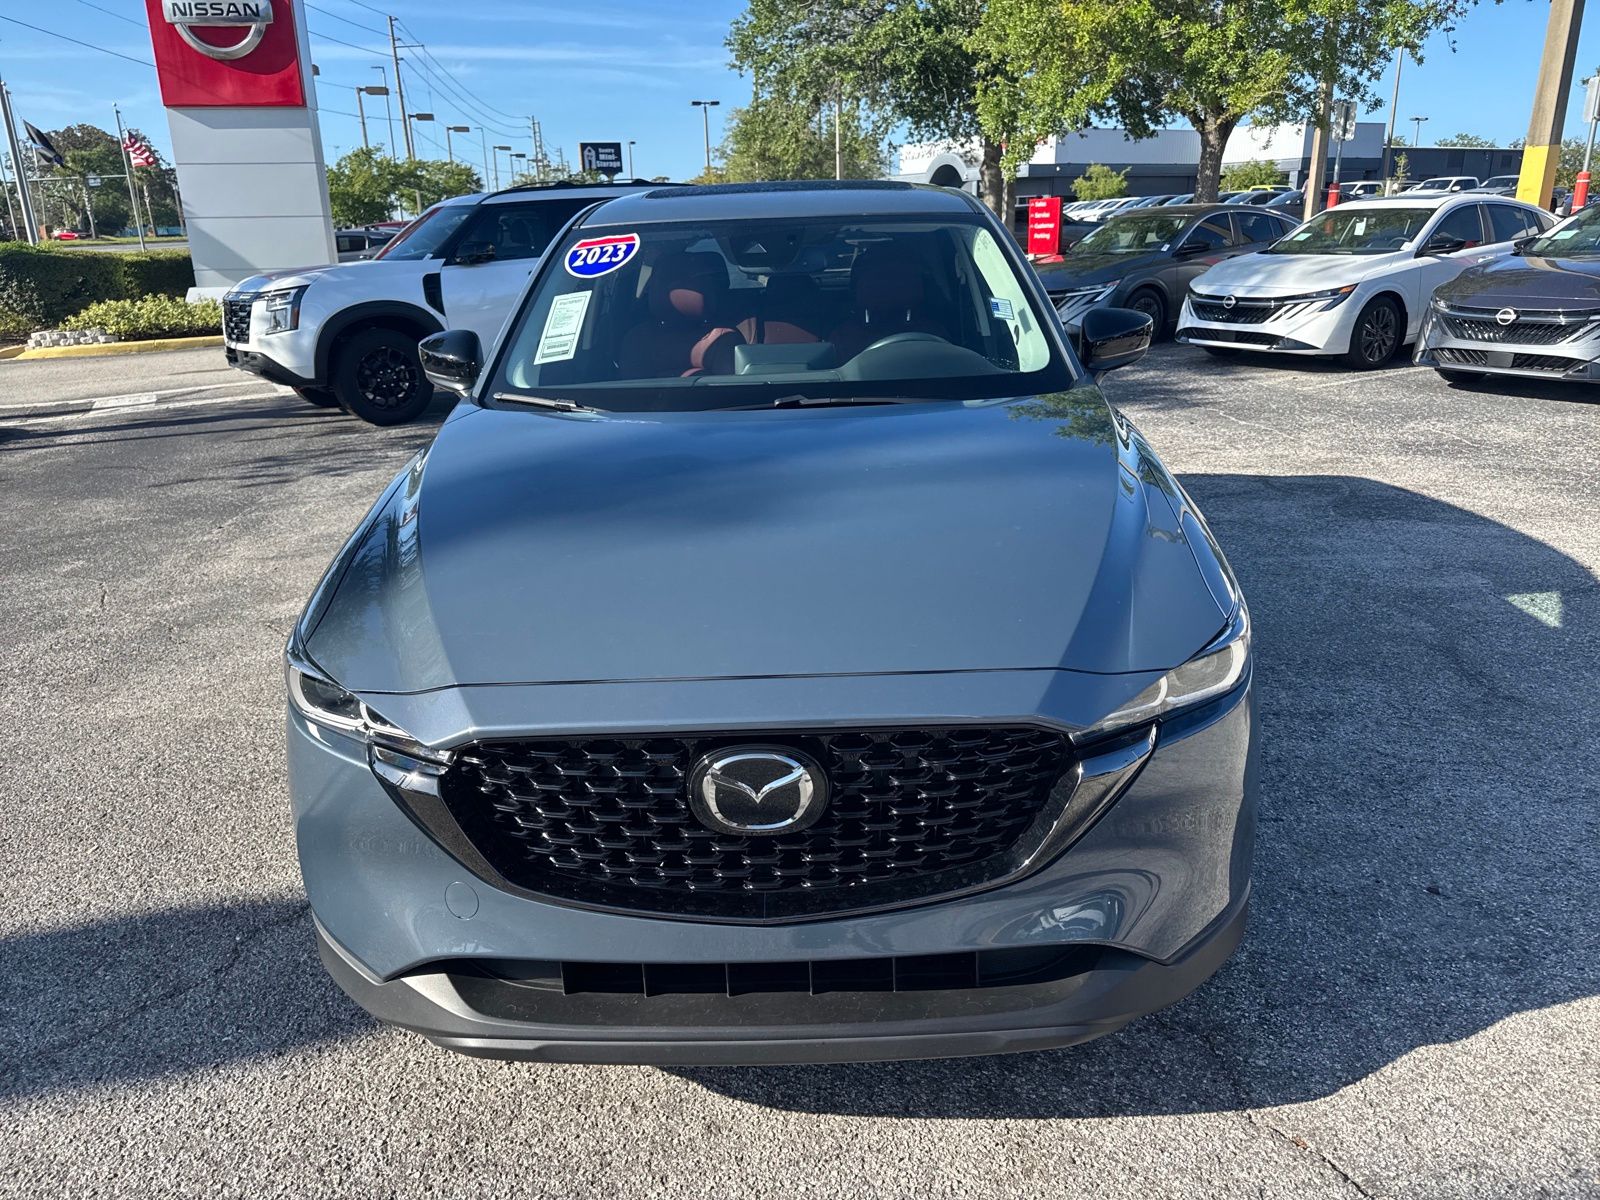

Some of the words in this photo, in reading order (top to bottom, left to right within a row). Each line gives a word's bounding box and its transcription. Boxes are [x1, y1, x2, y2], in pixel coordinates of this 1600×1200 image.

[172, 2, 261, 17] NISSAN
[596, 160, 621, 168] Storage
[571, 244, 627, 267] 2023
